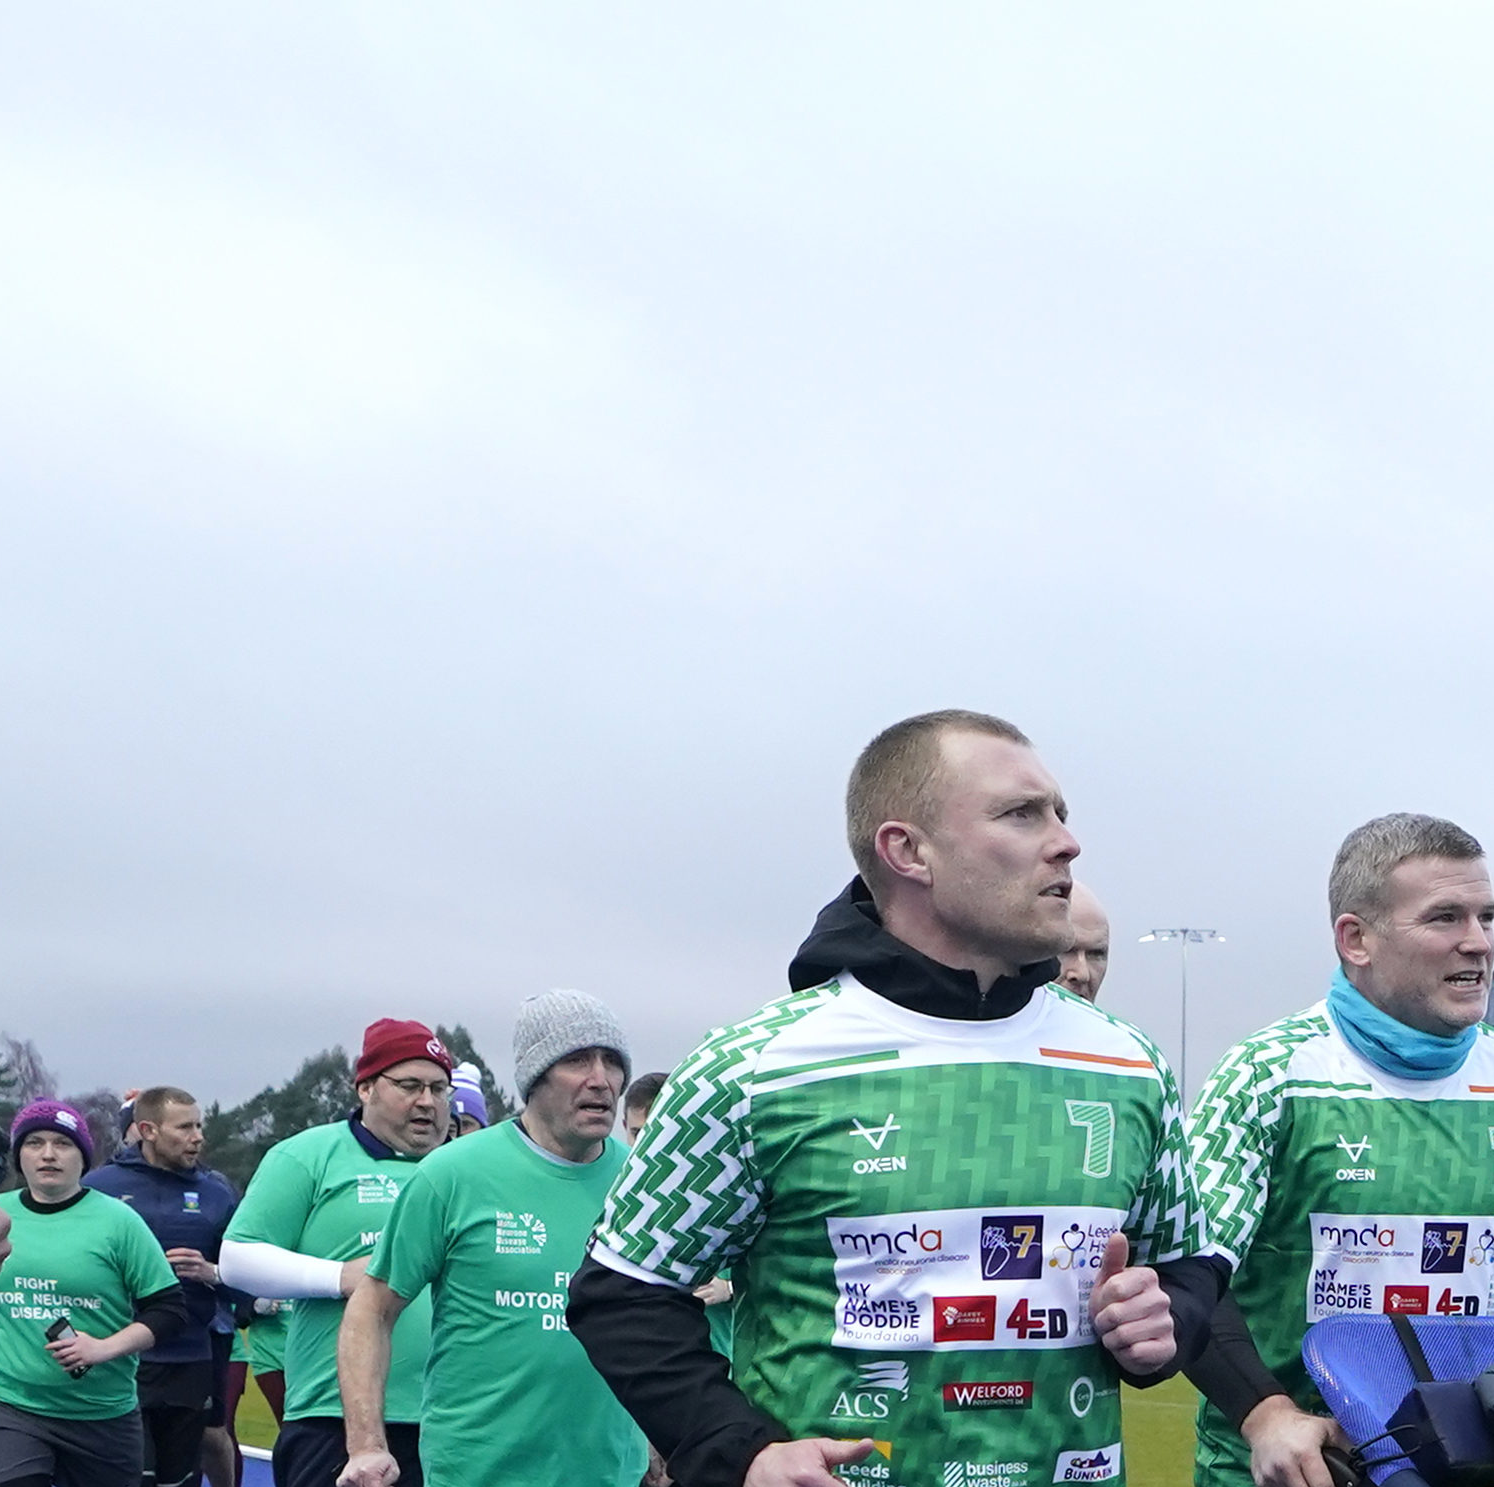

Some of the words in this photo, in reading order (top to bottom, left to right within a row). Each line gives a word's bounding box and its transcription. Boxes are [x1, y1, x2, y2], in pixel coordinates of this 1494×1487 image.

[852, 1155, 907, 1175] OXEN
[1335, 1168, 1376, 1182] OXEN
[840, 1223, 943, 1255] mnda
[1320, 1223, 1395, 1248] mnda
[1315, 1269, 1338, 1281] MY
[14, 1277, 58, 1291] FIGHT
[844, 1281, 871, 1297] MY
[1314, 1282, 1371, 1296] NAME'S
[32, 1294, 102, 1310] NEURONE
[495, 1290, 565, 1311] MOTOR
[844, 1298, 917, 1314] NAME'S
[1314, 1294, 1372, 1310] DODDIE
[11, 1307, 71, 1321] DISEASE
[843, 1312, 920, 1329] DODDIE
[842, 1327, 919, 1343] foundation
[953, 1385, 1024, 1406] WELFORD
[829, 1391, 890, 1418] ACS
[839, 1462, 890, 1479] Leeds
[966, 1460, 1028, 1476] business
